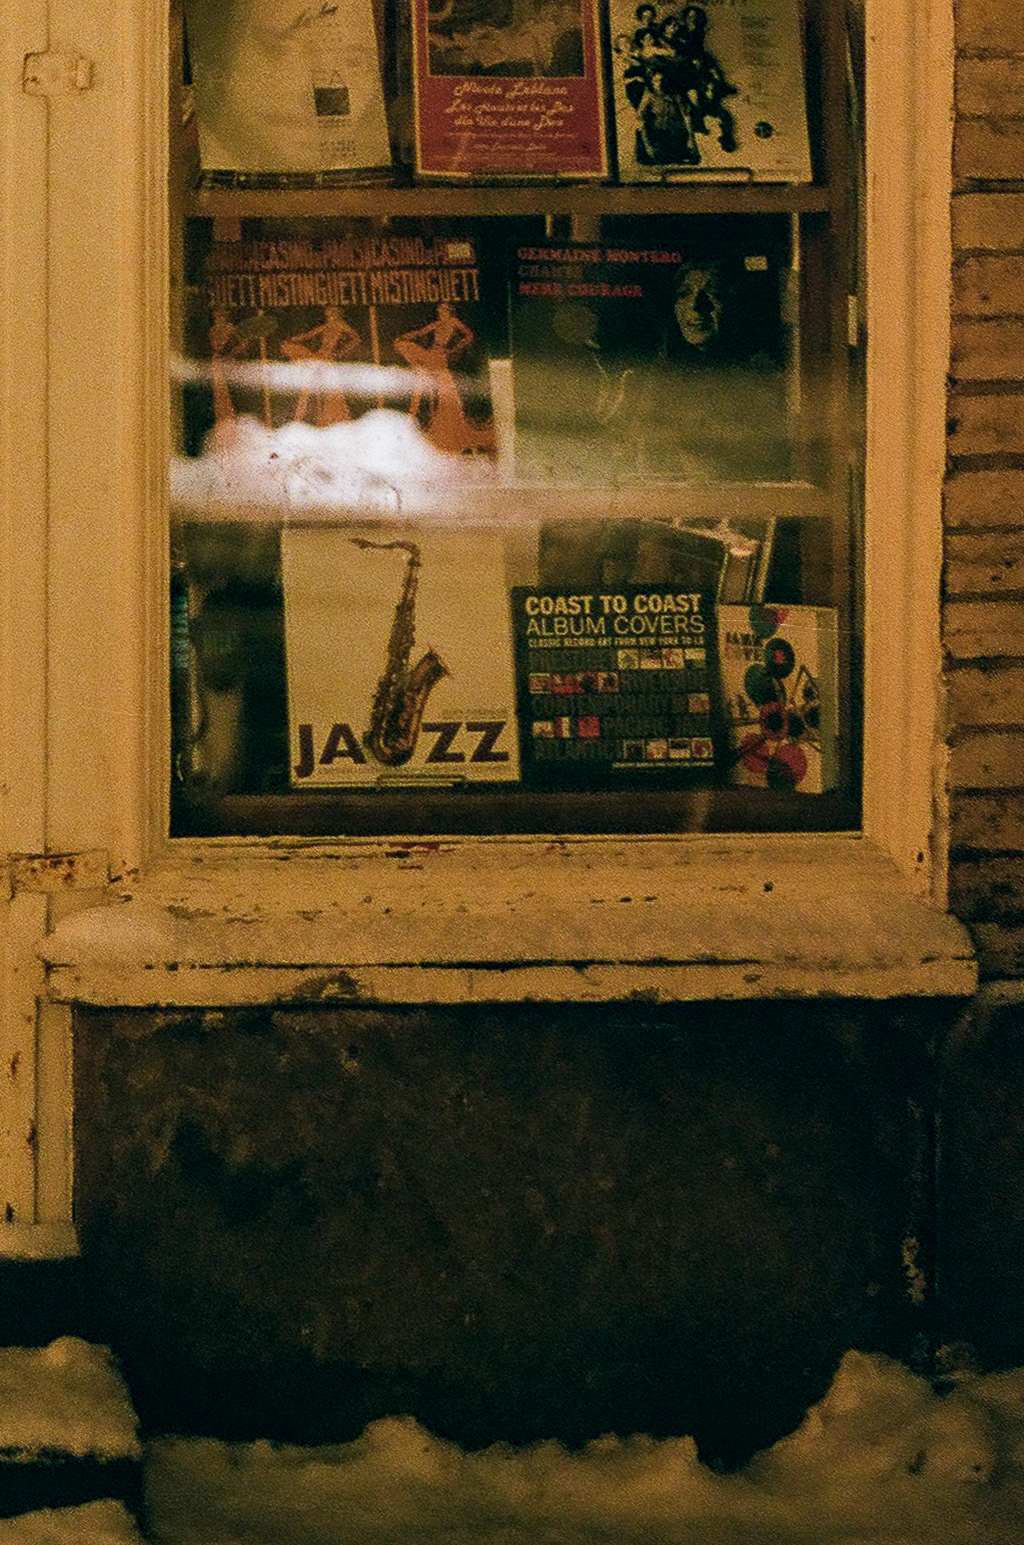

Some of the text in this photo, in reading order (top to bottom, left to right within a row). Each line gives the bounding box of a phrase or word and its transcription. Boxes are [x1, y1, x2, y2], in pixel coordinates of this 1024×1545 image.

[517, 247, 602, 263] GERMAINE
[370, 268, 480, 304] MISTINGUETT
[567, 283, 643, 298] COURAGE
[526, 593, 702, 615] COAST TO COAST
[526, 614, 706, 636] ALBUM COVERS
[293, 720, 510, 779] JAZZ
